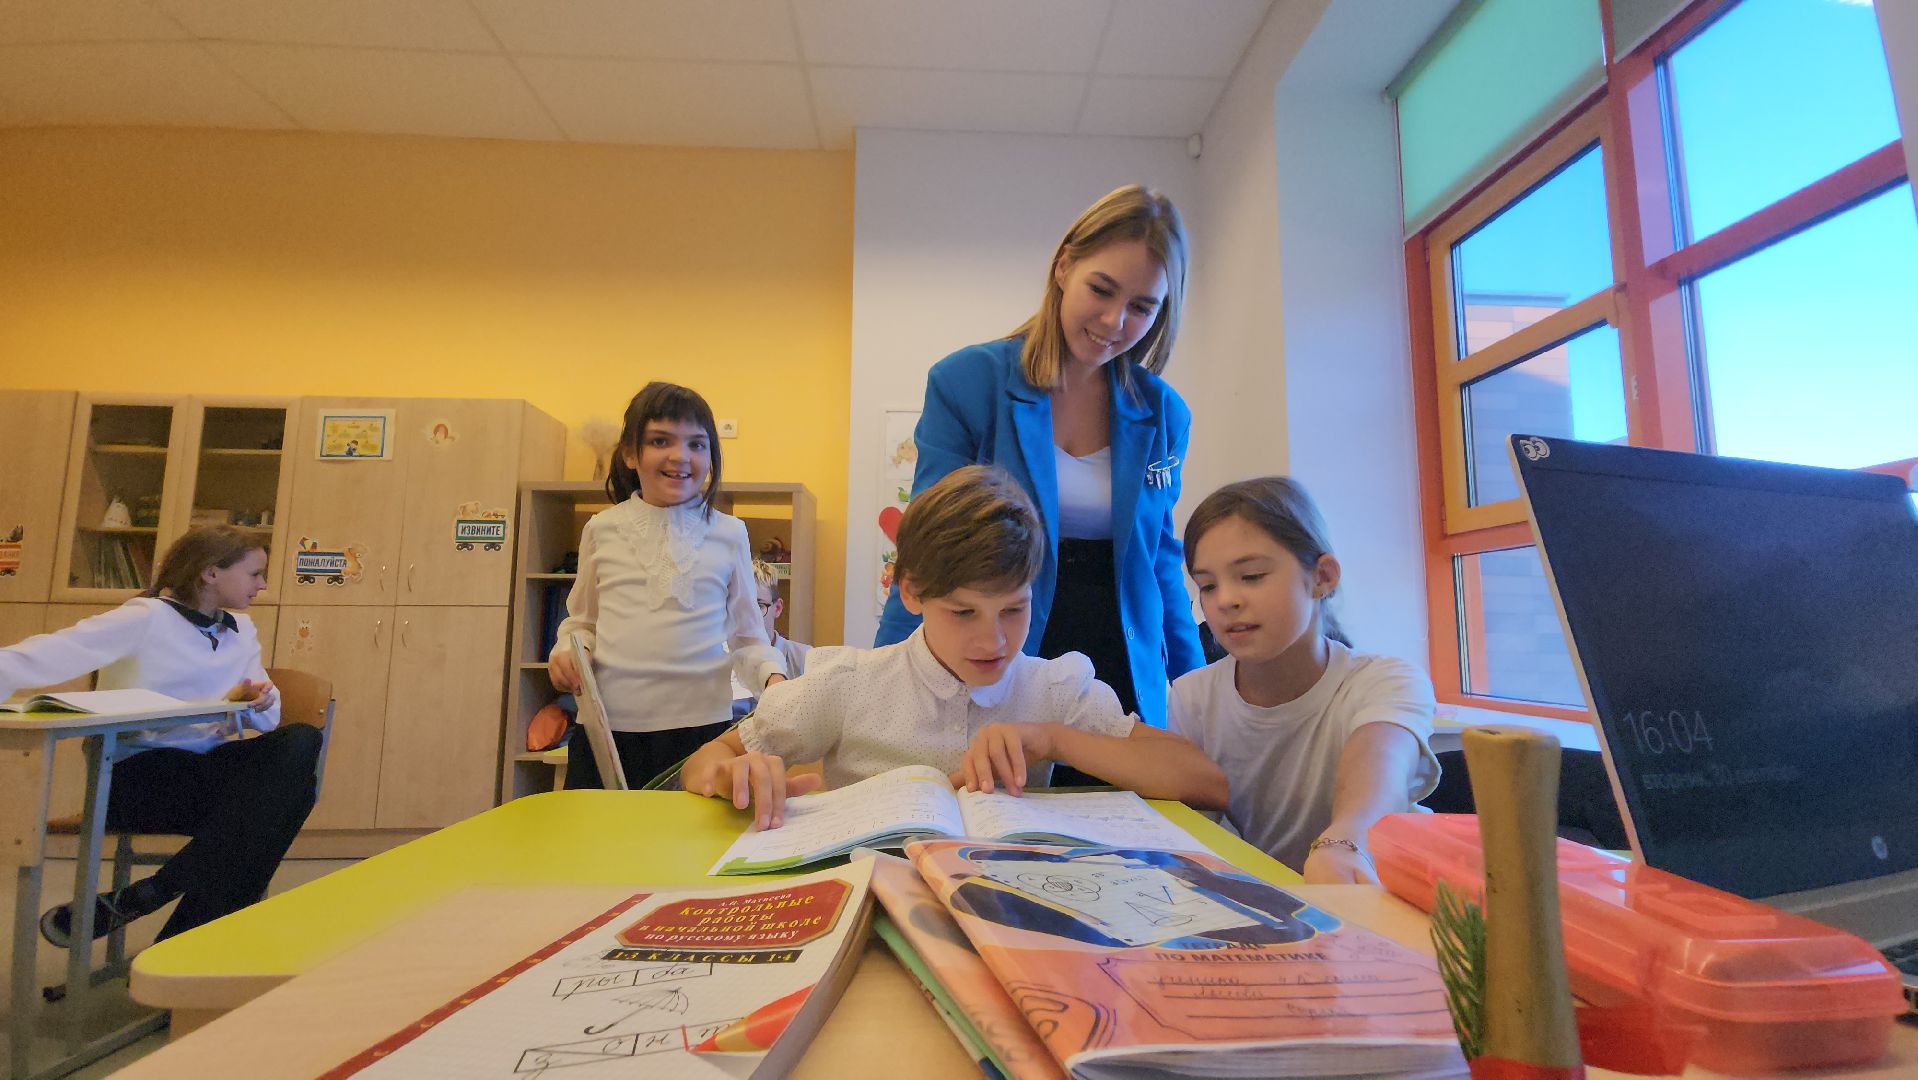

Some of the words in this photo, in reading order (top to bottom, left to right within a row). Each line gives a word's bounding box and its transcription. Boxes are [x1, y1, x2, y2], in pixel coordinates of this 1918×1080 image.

[460, 525, 501, 536] ИЗВИНИТЕ
[298, 556, 348, 568] ПОЖАЛУЙСТА
[1623, 710, 1713, 754] 16:04
[680, 895, 815, 918] Контрольные
[653, 921, 757, 933] начальной
[760, 915, 822, 931] школе
[697, 912, 775, 927] работы
[665, 934, 745, 943] русскому
[748, 930, 799, 940] языку
[1181, 942, 1267, 951] ТЕТРАДЬ
[648, 952, 757, 963] КЛАССЫ
[1154, 952, 1186, 961] ПО
[1191, 952, 1328, 962] МАТЕМАТИКЕ
